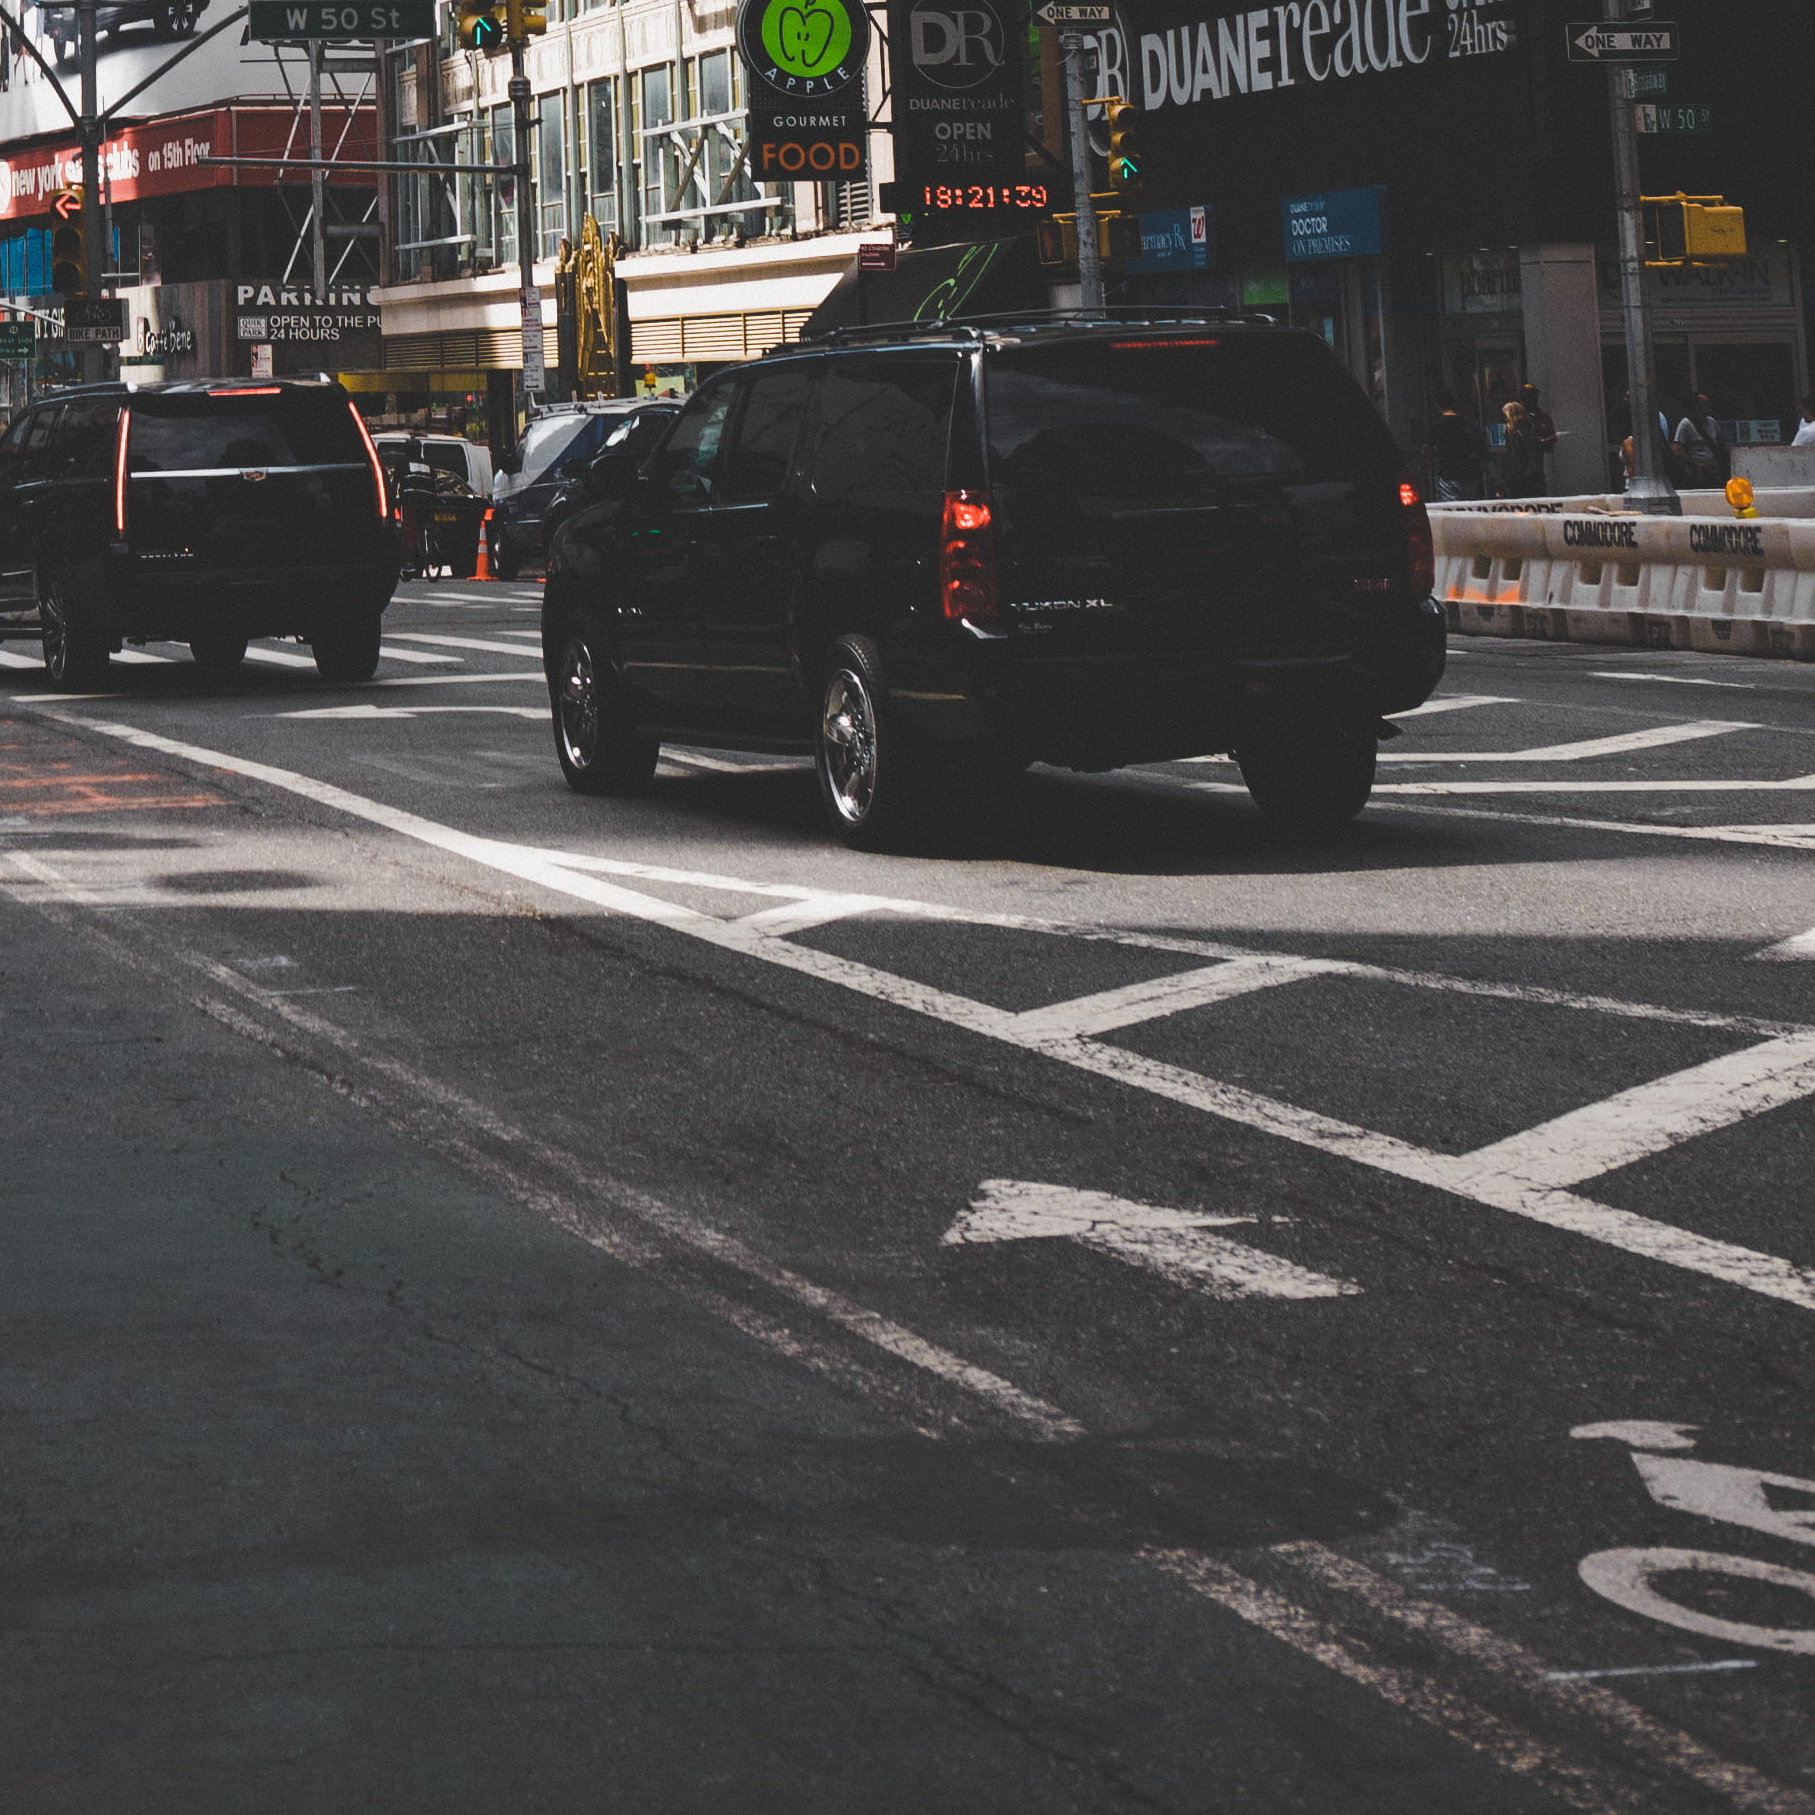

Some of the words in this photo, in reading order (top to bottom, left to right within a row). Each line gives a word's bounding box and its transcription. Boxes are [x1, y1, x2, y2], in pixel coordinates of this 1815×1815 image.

[286, 8, 307, 30] W
[321, 8, 358, 30] 50
[370, 7, 400, 30] St
[1047, 6, 1072, 19] ONE
[1078, 6, 1104, 19] WAY
[1447, 11, 1510, 58] 24hrs
[1585, 34, 1616, 49] ONE
[1630, 34, 1665, 49] WAY
[765, 66, 849, 93] APPLE
[773, 115, 846, 127] GOURMET
[1659, 109, 1670, 129] W
[1678, 109, 1695, 129] 50
[935, 122, 992, 139] OPEN
[148, 151, 161, 172] on
[163, 142, 183, 169] 15th
[185, 138, 210, 166] Floor
[762, 143, 860, 170] FOOD
[11, 169, 35, 197] new
[37, 154, 63, 201] york
[106, 141, 140, 180] clubs
[1291, 217, 1328, 236] DOCTOR
[241, 319, 264, 327] QUIK
[270, 315, 310, 328] OPEN
[314, 316, 332, 328] TO
[336, 316, 363, 328] THE
[68, 328, 94, 341] BIKE
[96, 328, 120, 341] PATH
[241, 327, 264, 337] PARK
[270, 328, 286, 340] 24
[289, 328, 340, 340] HOURS
[1564, 520, 1638, 548] COMMODORE
[1690, 524, 1764, 556] COMMODORE
[1085, 598, 1113, 609] XL
